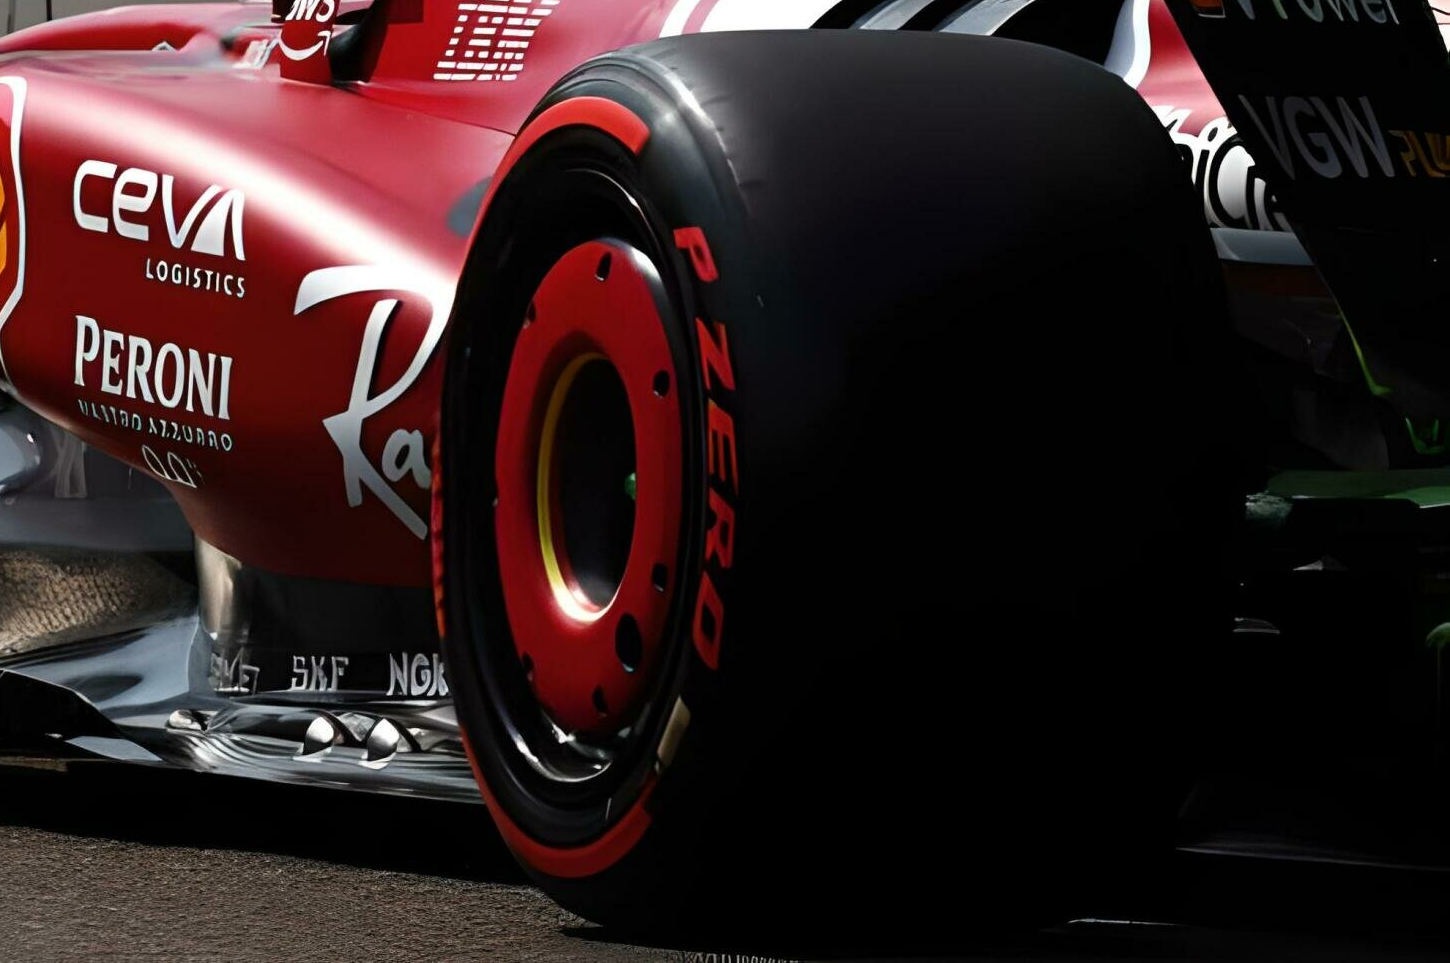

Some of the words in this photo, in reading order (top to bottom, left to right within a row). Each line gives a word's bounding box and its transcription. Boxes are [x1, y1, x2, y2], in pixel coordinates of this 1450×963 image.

[1238, 94, 1396, 180] VGW
[145, 258, 246, 299] LOGISTICS
[74, 314, 233, 420] PERONI
[294, 265, 455, 540] Ra
[693, 316, 740, 671] ZERO
[291, 655, 349, 691] SKF
